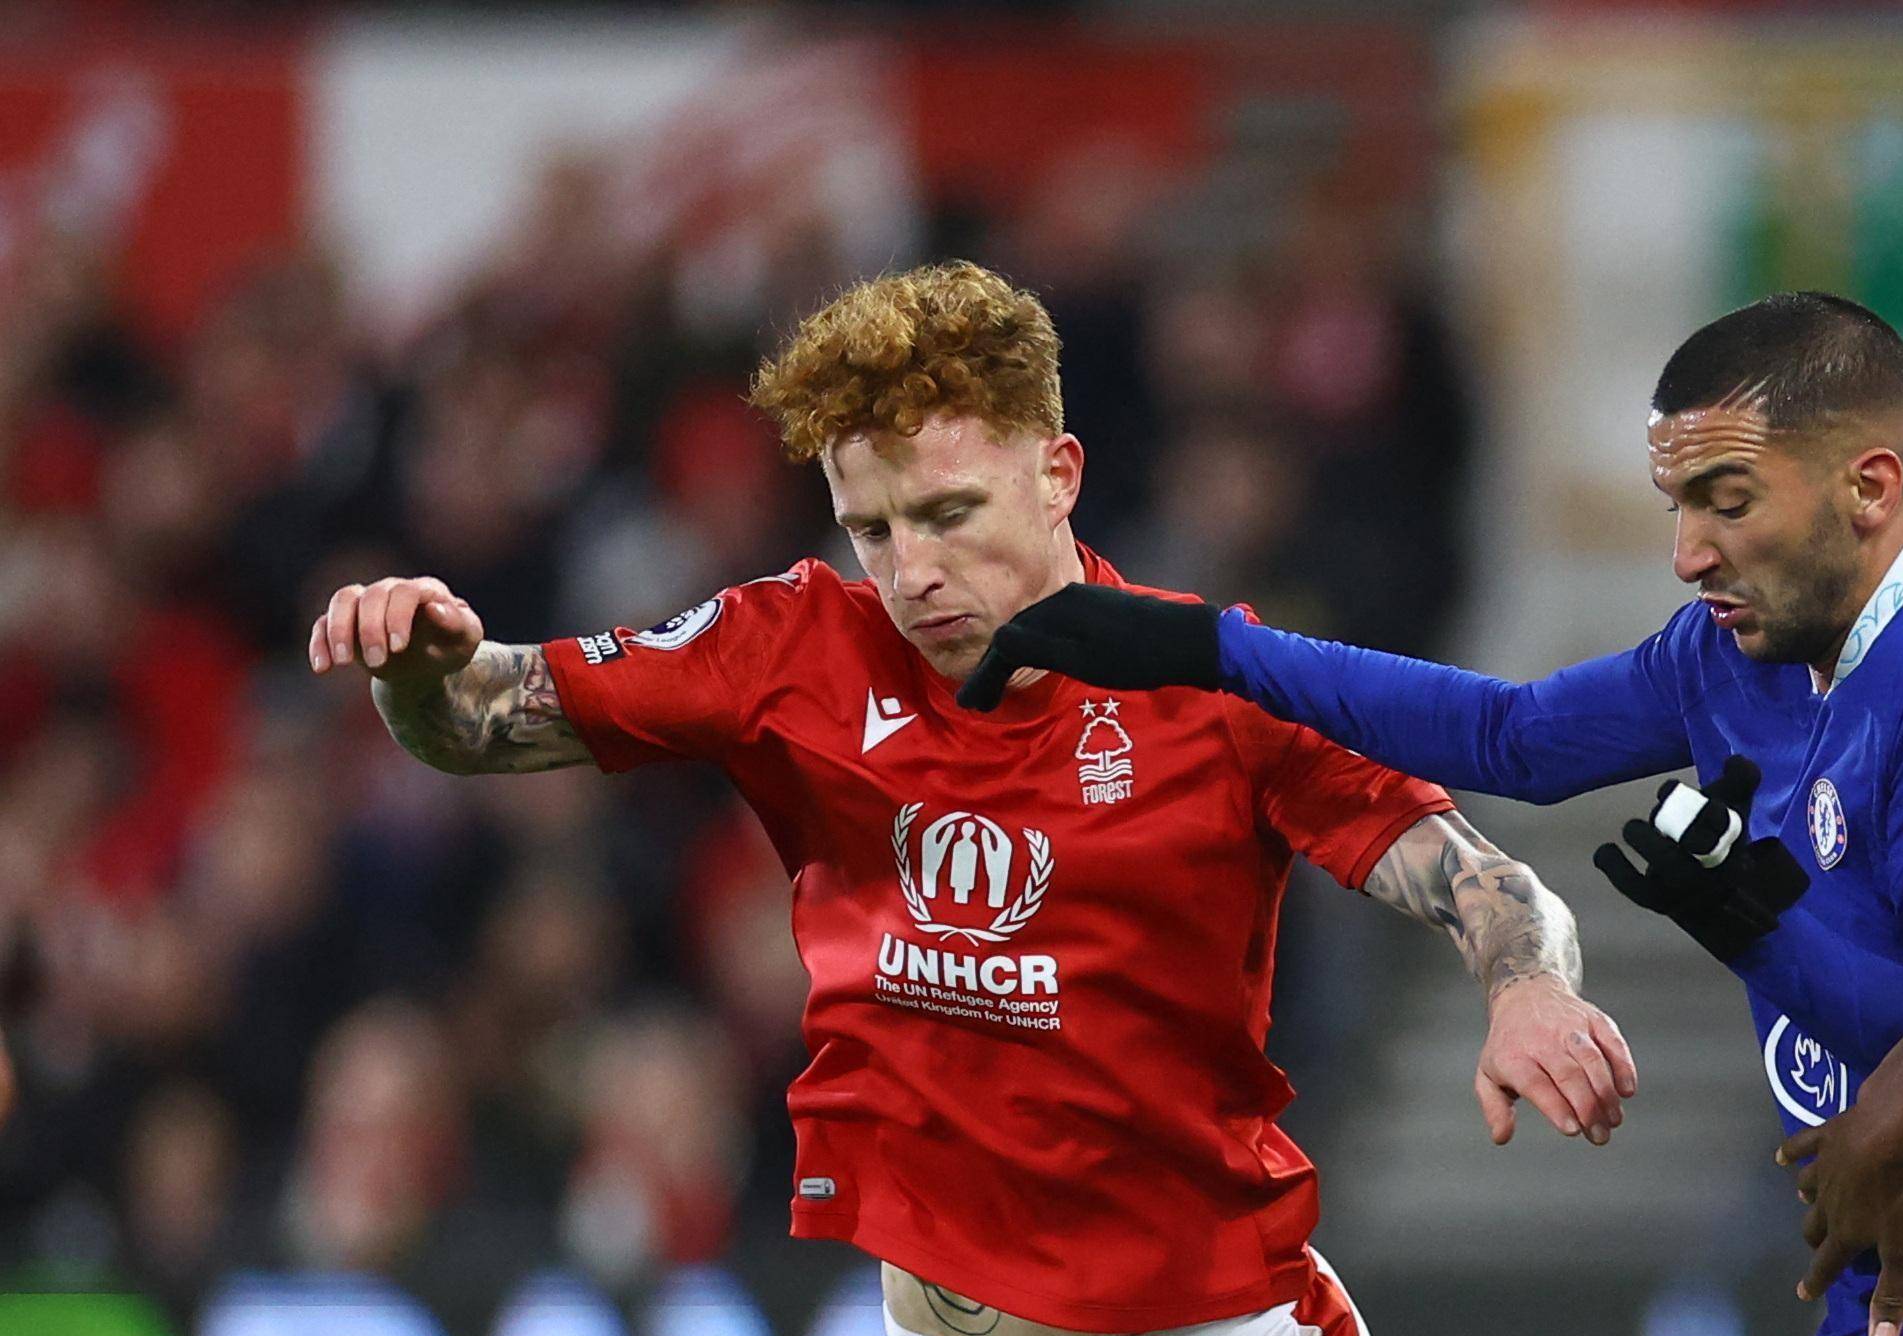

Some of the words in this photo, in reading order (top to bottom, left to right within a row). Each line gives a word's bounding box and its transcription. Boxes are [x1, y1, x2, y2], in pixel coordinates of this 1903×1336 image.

[877, 931, 1060, 996] UNHCR
[874, 973, 901, 994] The
[903, 981, 928, 998] UN
[930, 985, 995, 1009] Refugee
[997, 997, 1060, 1015] Agency
[921, 1000, 983, 1019] Kingdom
[983, 1009, 1004, 1023] for
[1005, 1014, 1062, 1031] UNHCR
